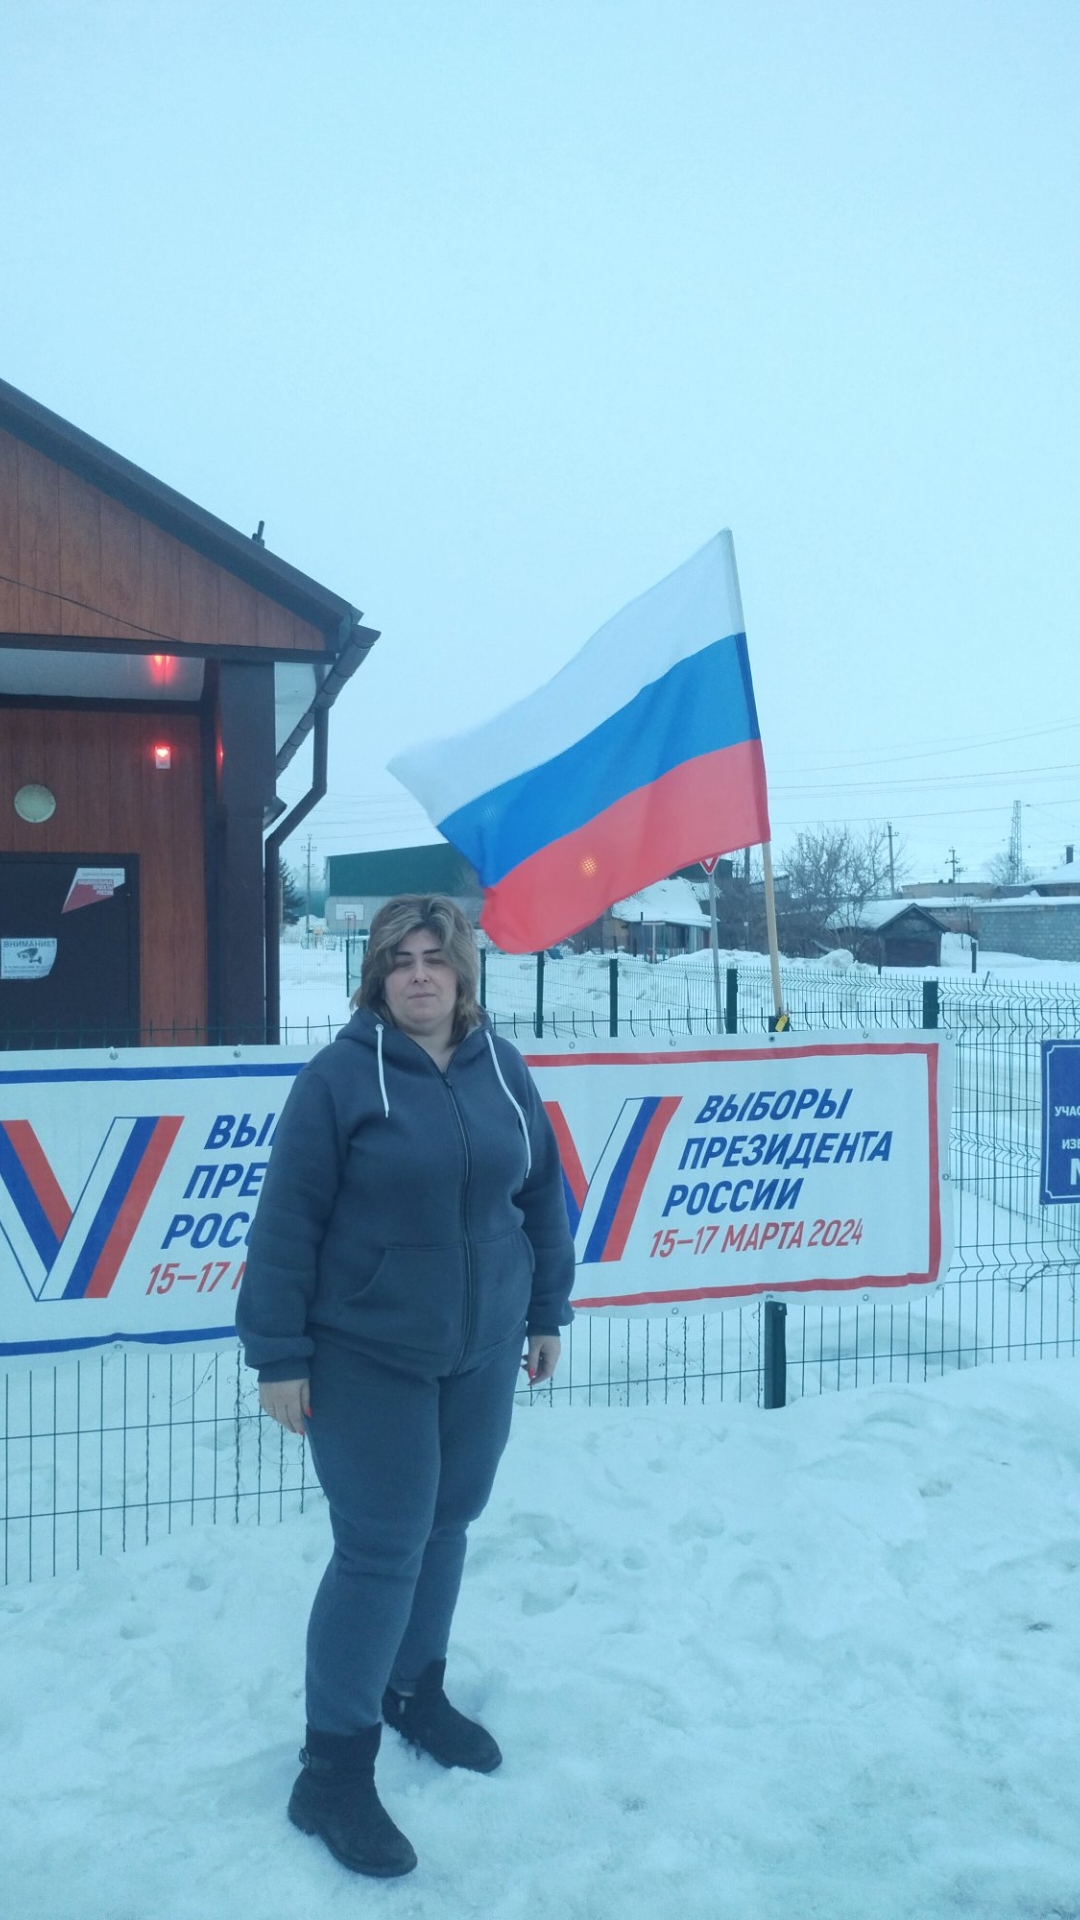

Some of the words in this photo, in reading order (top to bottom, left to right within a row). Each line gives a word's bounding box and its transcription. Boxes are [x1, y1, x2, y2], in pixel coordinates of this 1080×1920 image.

[3, 940, 55, 948] ВНИМАНИЕ!
[694, 1088, 854, 1124] ВЫБОРЫ
[203, 1112, 278, 1150] ВЫ
[677, 1130, 894, 1171] ПРЕЗИДЕНТА
[182, 1162, 269, 1199] ПРЕ
[661, 1177, 805, 1218] РОССИИ
[160, 1211, 256, 1250] РОС
[720, 1220, 805, 1254] МАРТА
[806, 1217, 864, 1248] 2024
